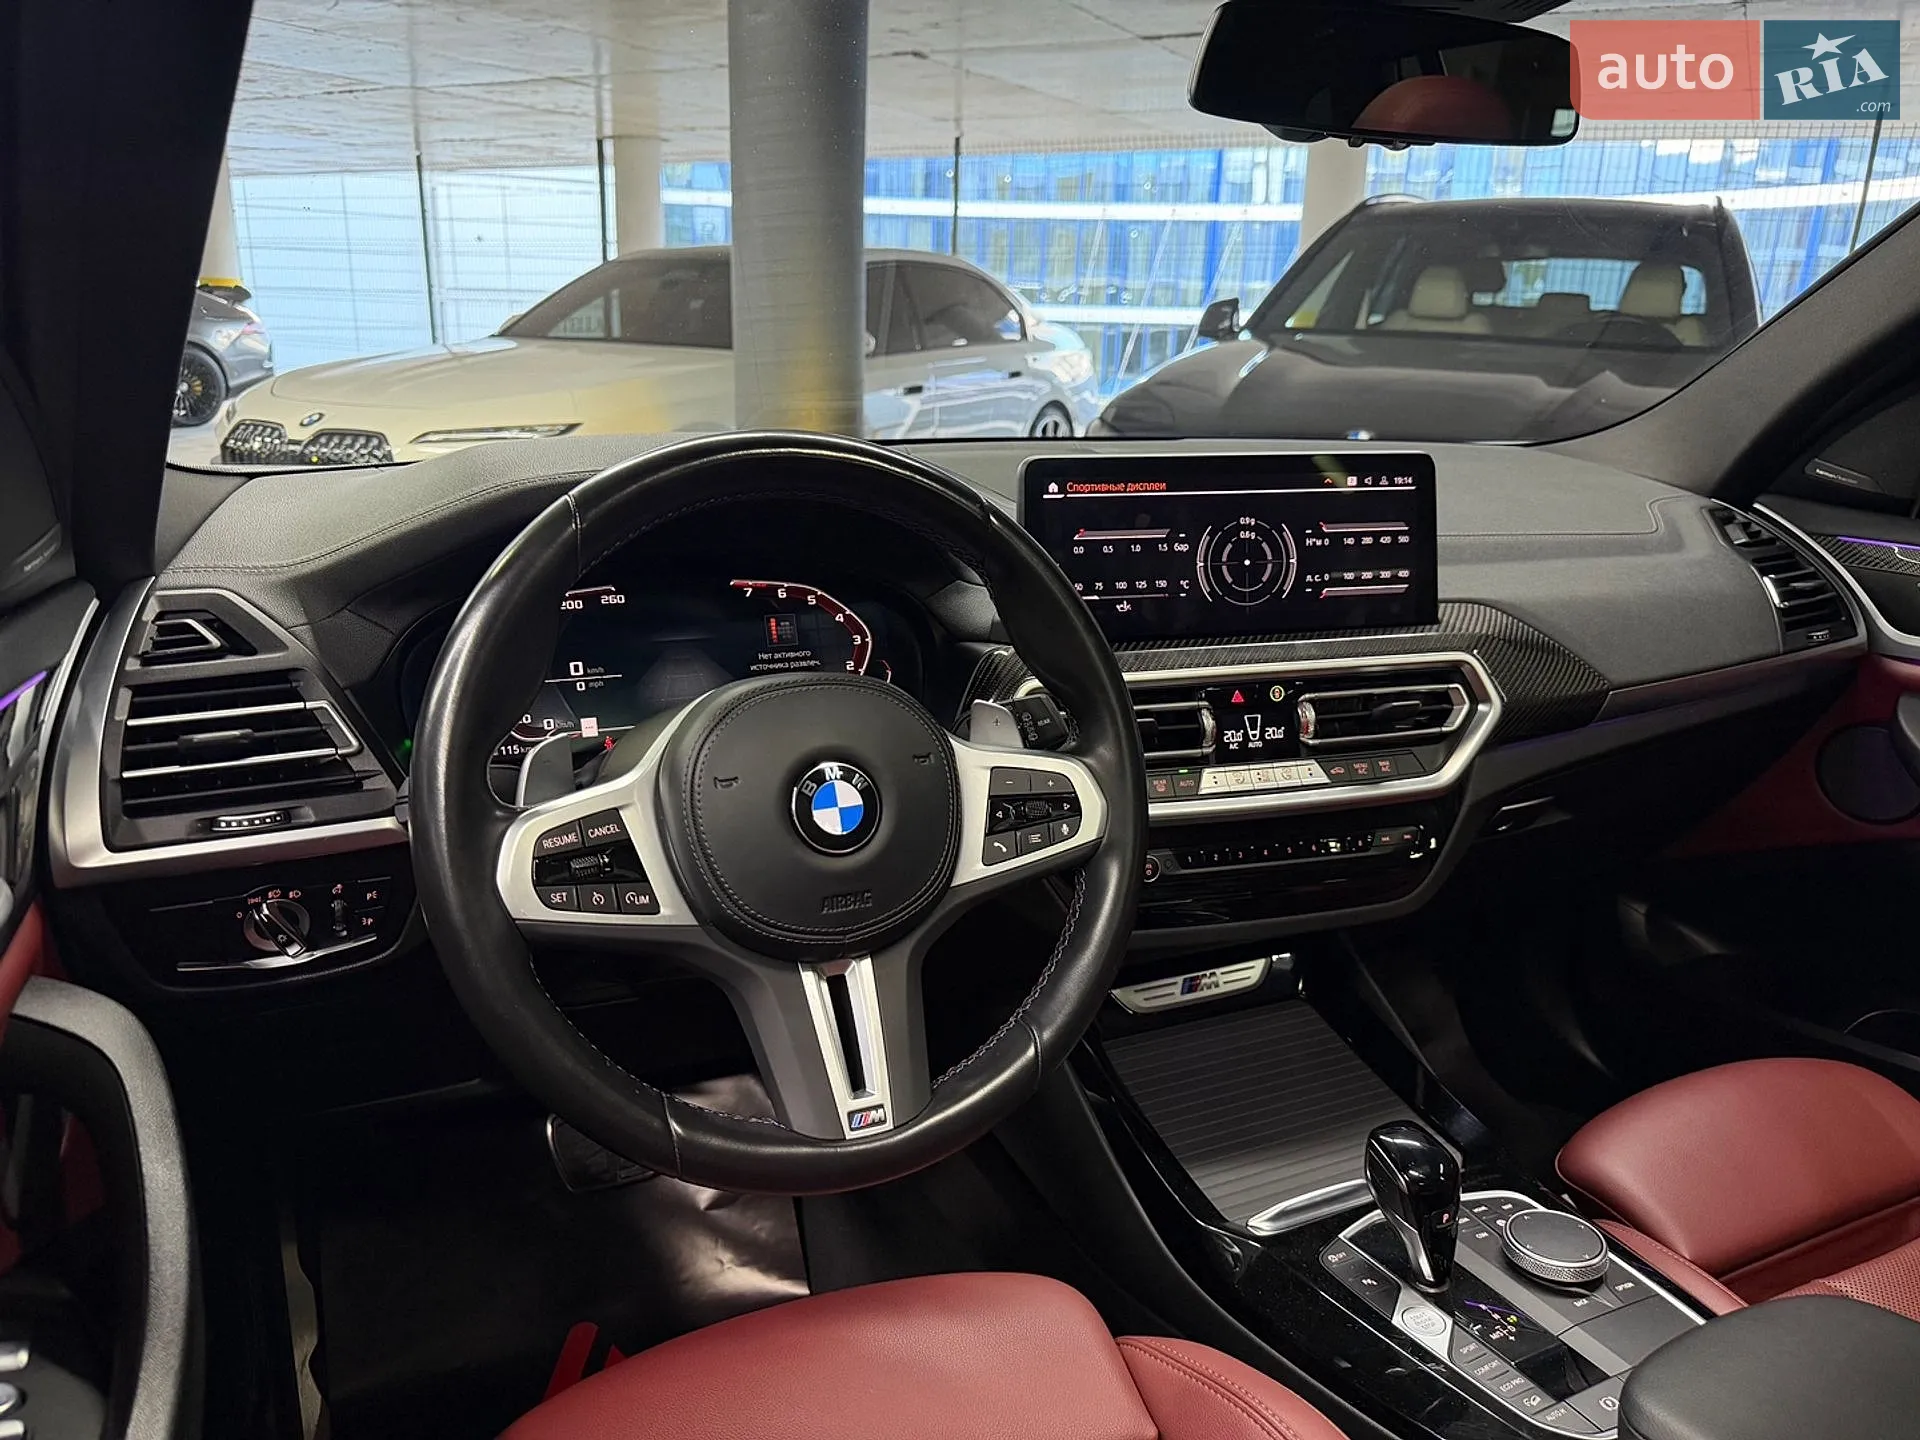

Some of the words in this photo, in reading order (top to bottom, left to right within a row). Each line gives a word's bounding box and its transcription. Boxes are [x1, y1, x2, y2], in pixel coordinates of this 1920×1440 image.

[1393, 476, 1413, 485] 19:14
[1066, 482, 1125, 492] Спортивные
[1073, 546, 1085, 554] 0.0
[1102, 545, 1114, 553] 0.5
[1130, 544, 1142, 552] 1.0
[1158, 543, 1168, 551] 1.5
[1094, 582, 1104, 590] 75
[1115, 581, 1128, 589] 100
[1135, 581, 1147, 589] 125
[743, 587, 753, 597] 7
[777, 588, 787, 599] 6
[600, 594, 626, 604] 260
[807, 595, 817, 605] 5
[834, 612, 845, 623] 4
[852, 634, 862, 645] 3
[569, 661, 584, 676] 0
[845, 660, 855, 671] 2
[576, 681, 586, 691] 0
[543, 718, 555, 731] 0
[500, 744, 520, 756] 115
[800, 765, 869, 797] BMW
[542, 832, 579, 849] RESUME
[587, 823, 621, 838] CANCEL
[550, 891, 568, 904] SET
[821, 891, 873, 915] AIRBAG
